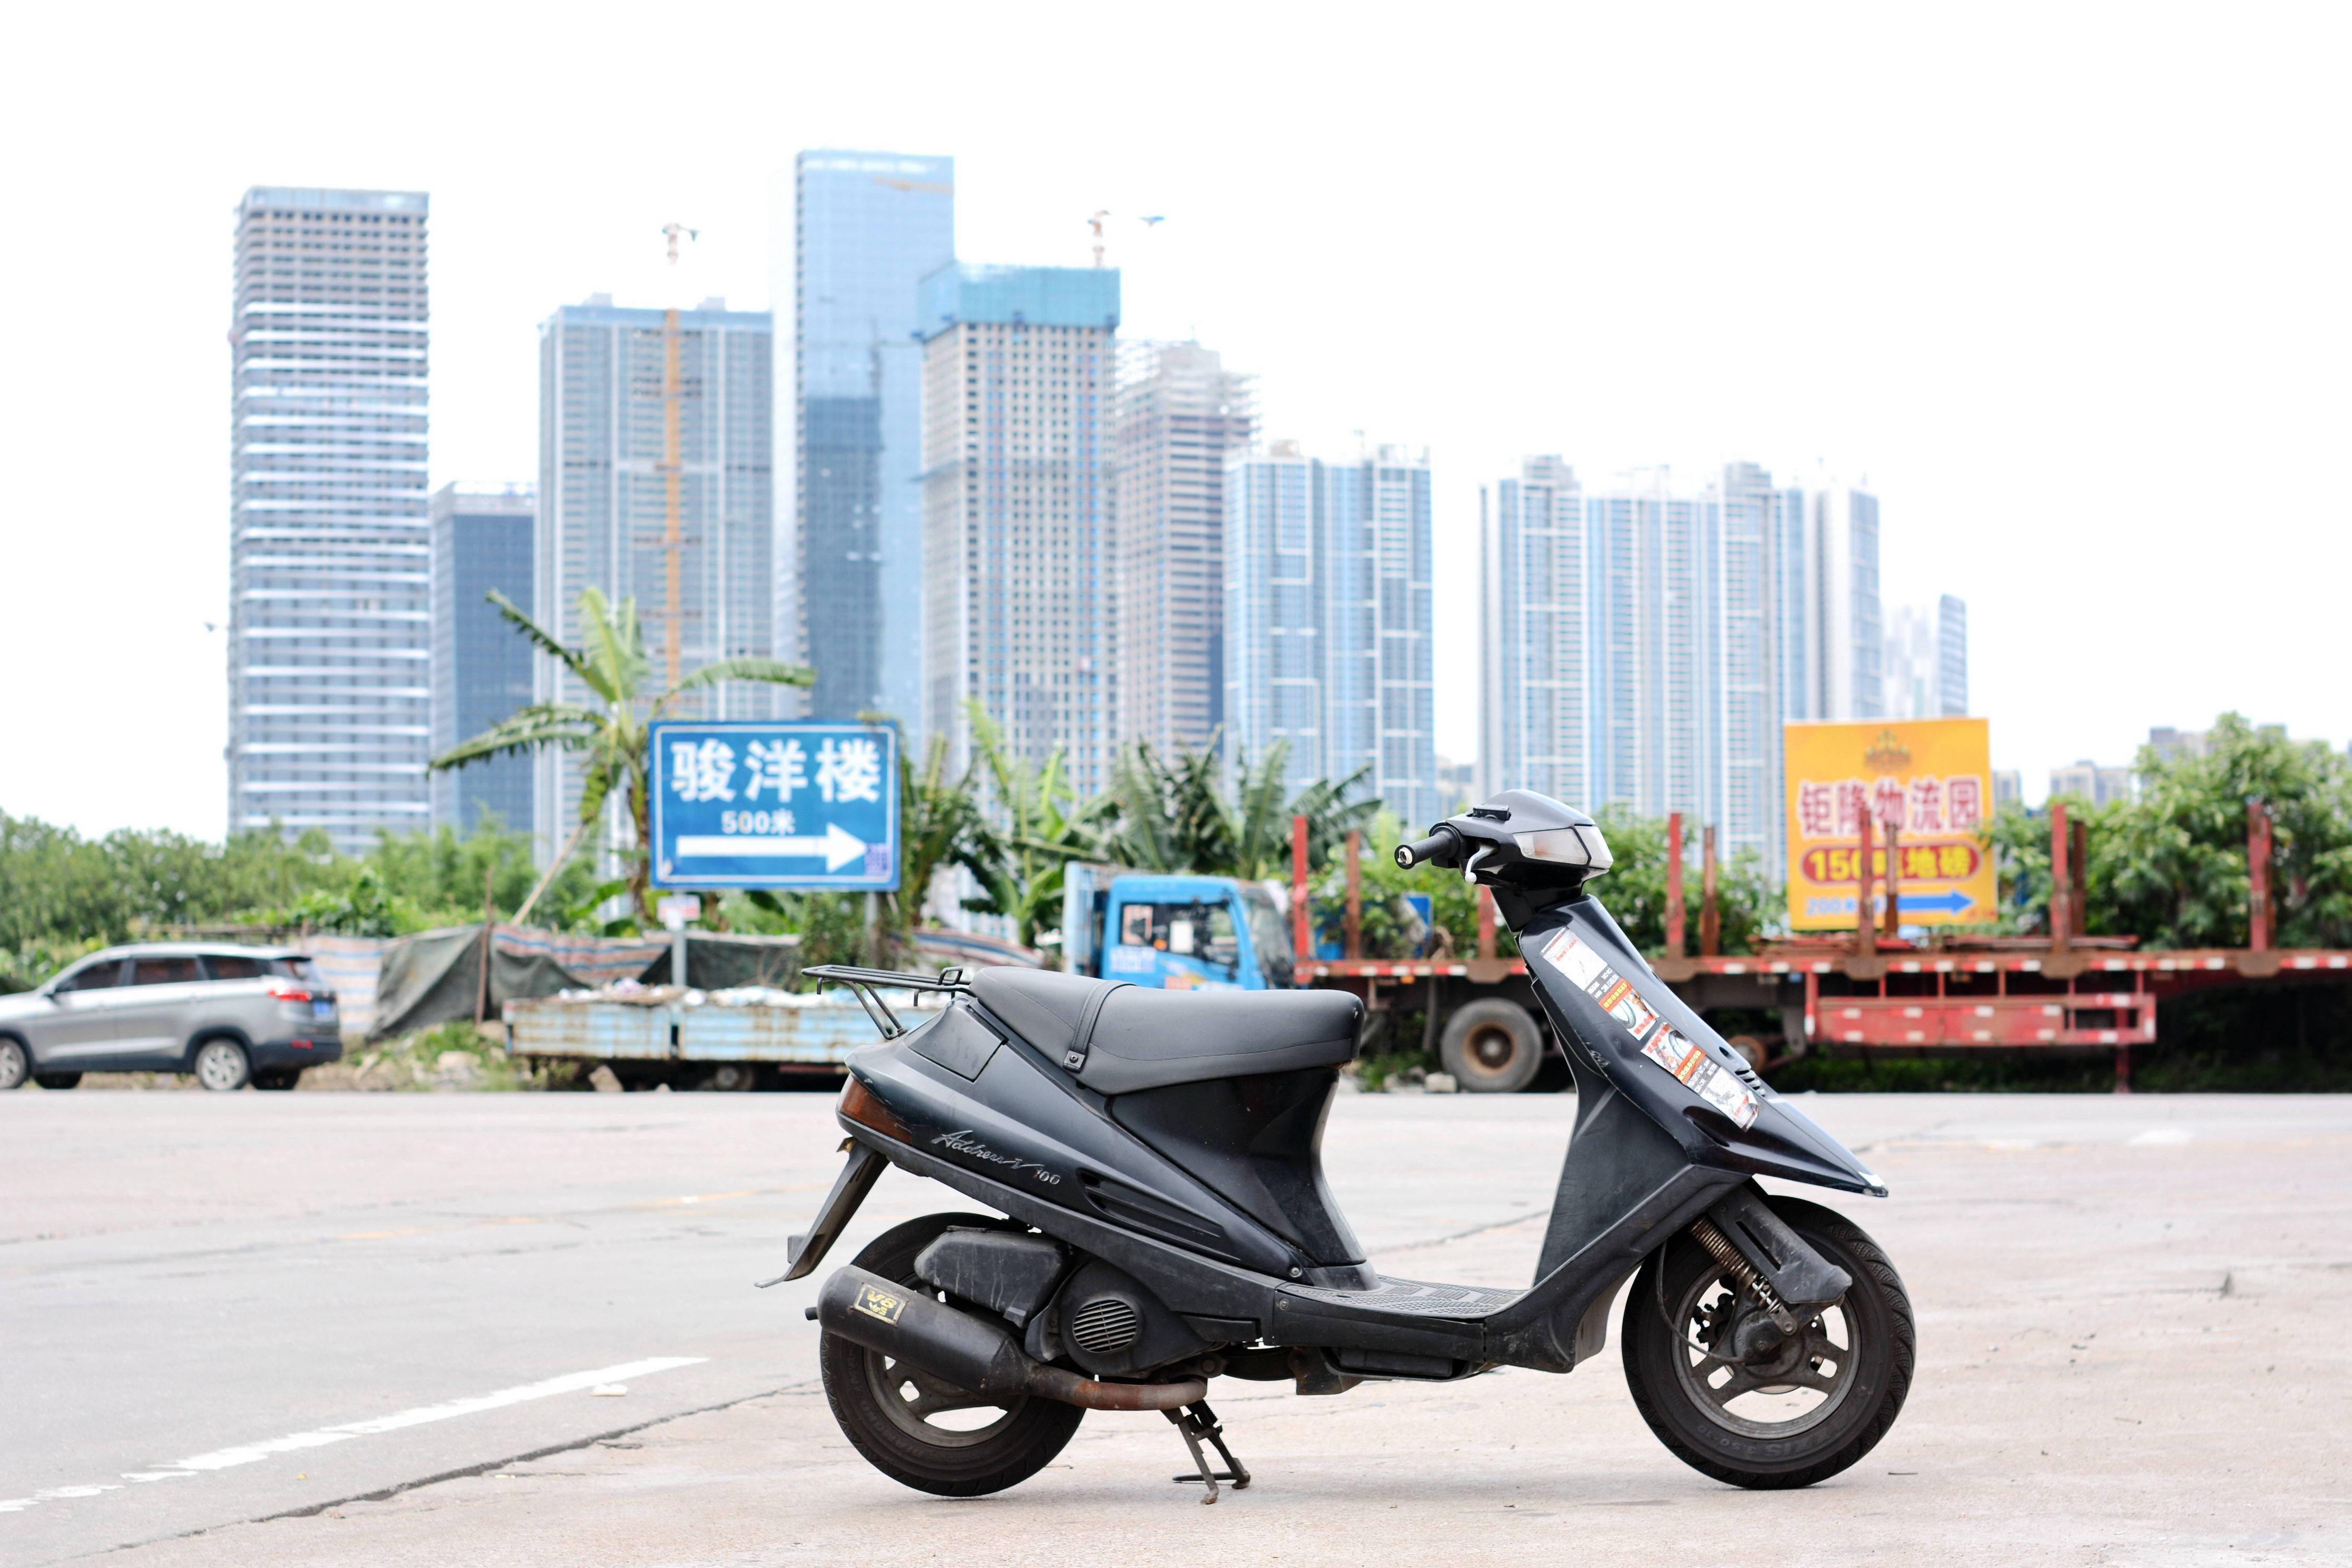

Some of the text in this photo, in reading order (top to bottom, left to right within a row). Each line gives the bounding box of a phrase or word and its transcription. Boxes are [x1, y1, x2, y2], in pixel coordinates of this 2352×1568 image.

[671, 739, 881, 803] 骏洋楼
[721, 808, 795, 835] 500米
[867, 1290, 897, 1309] V8
